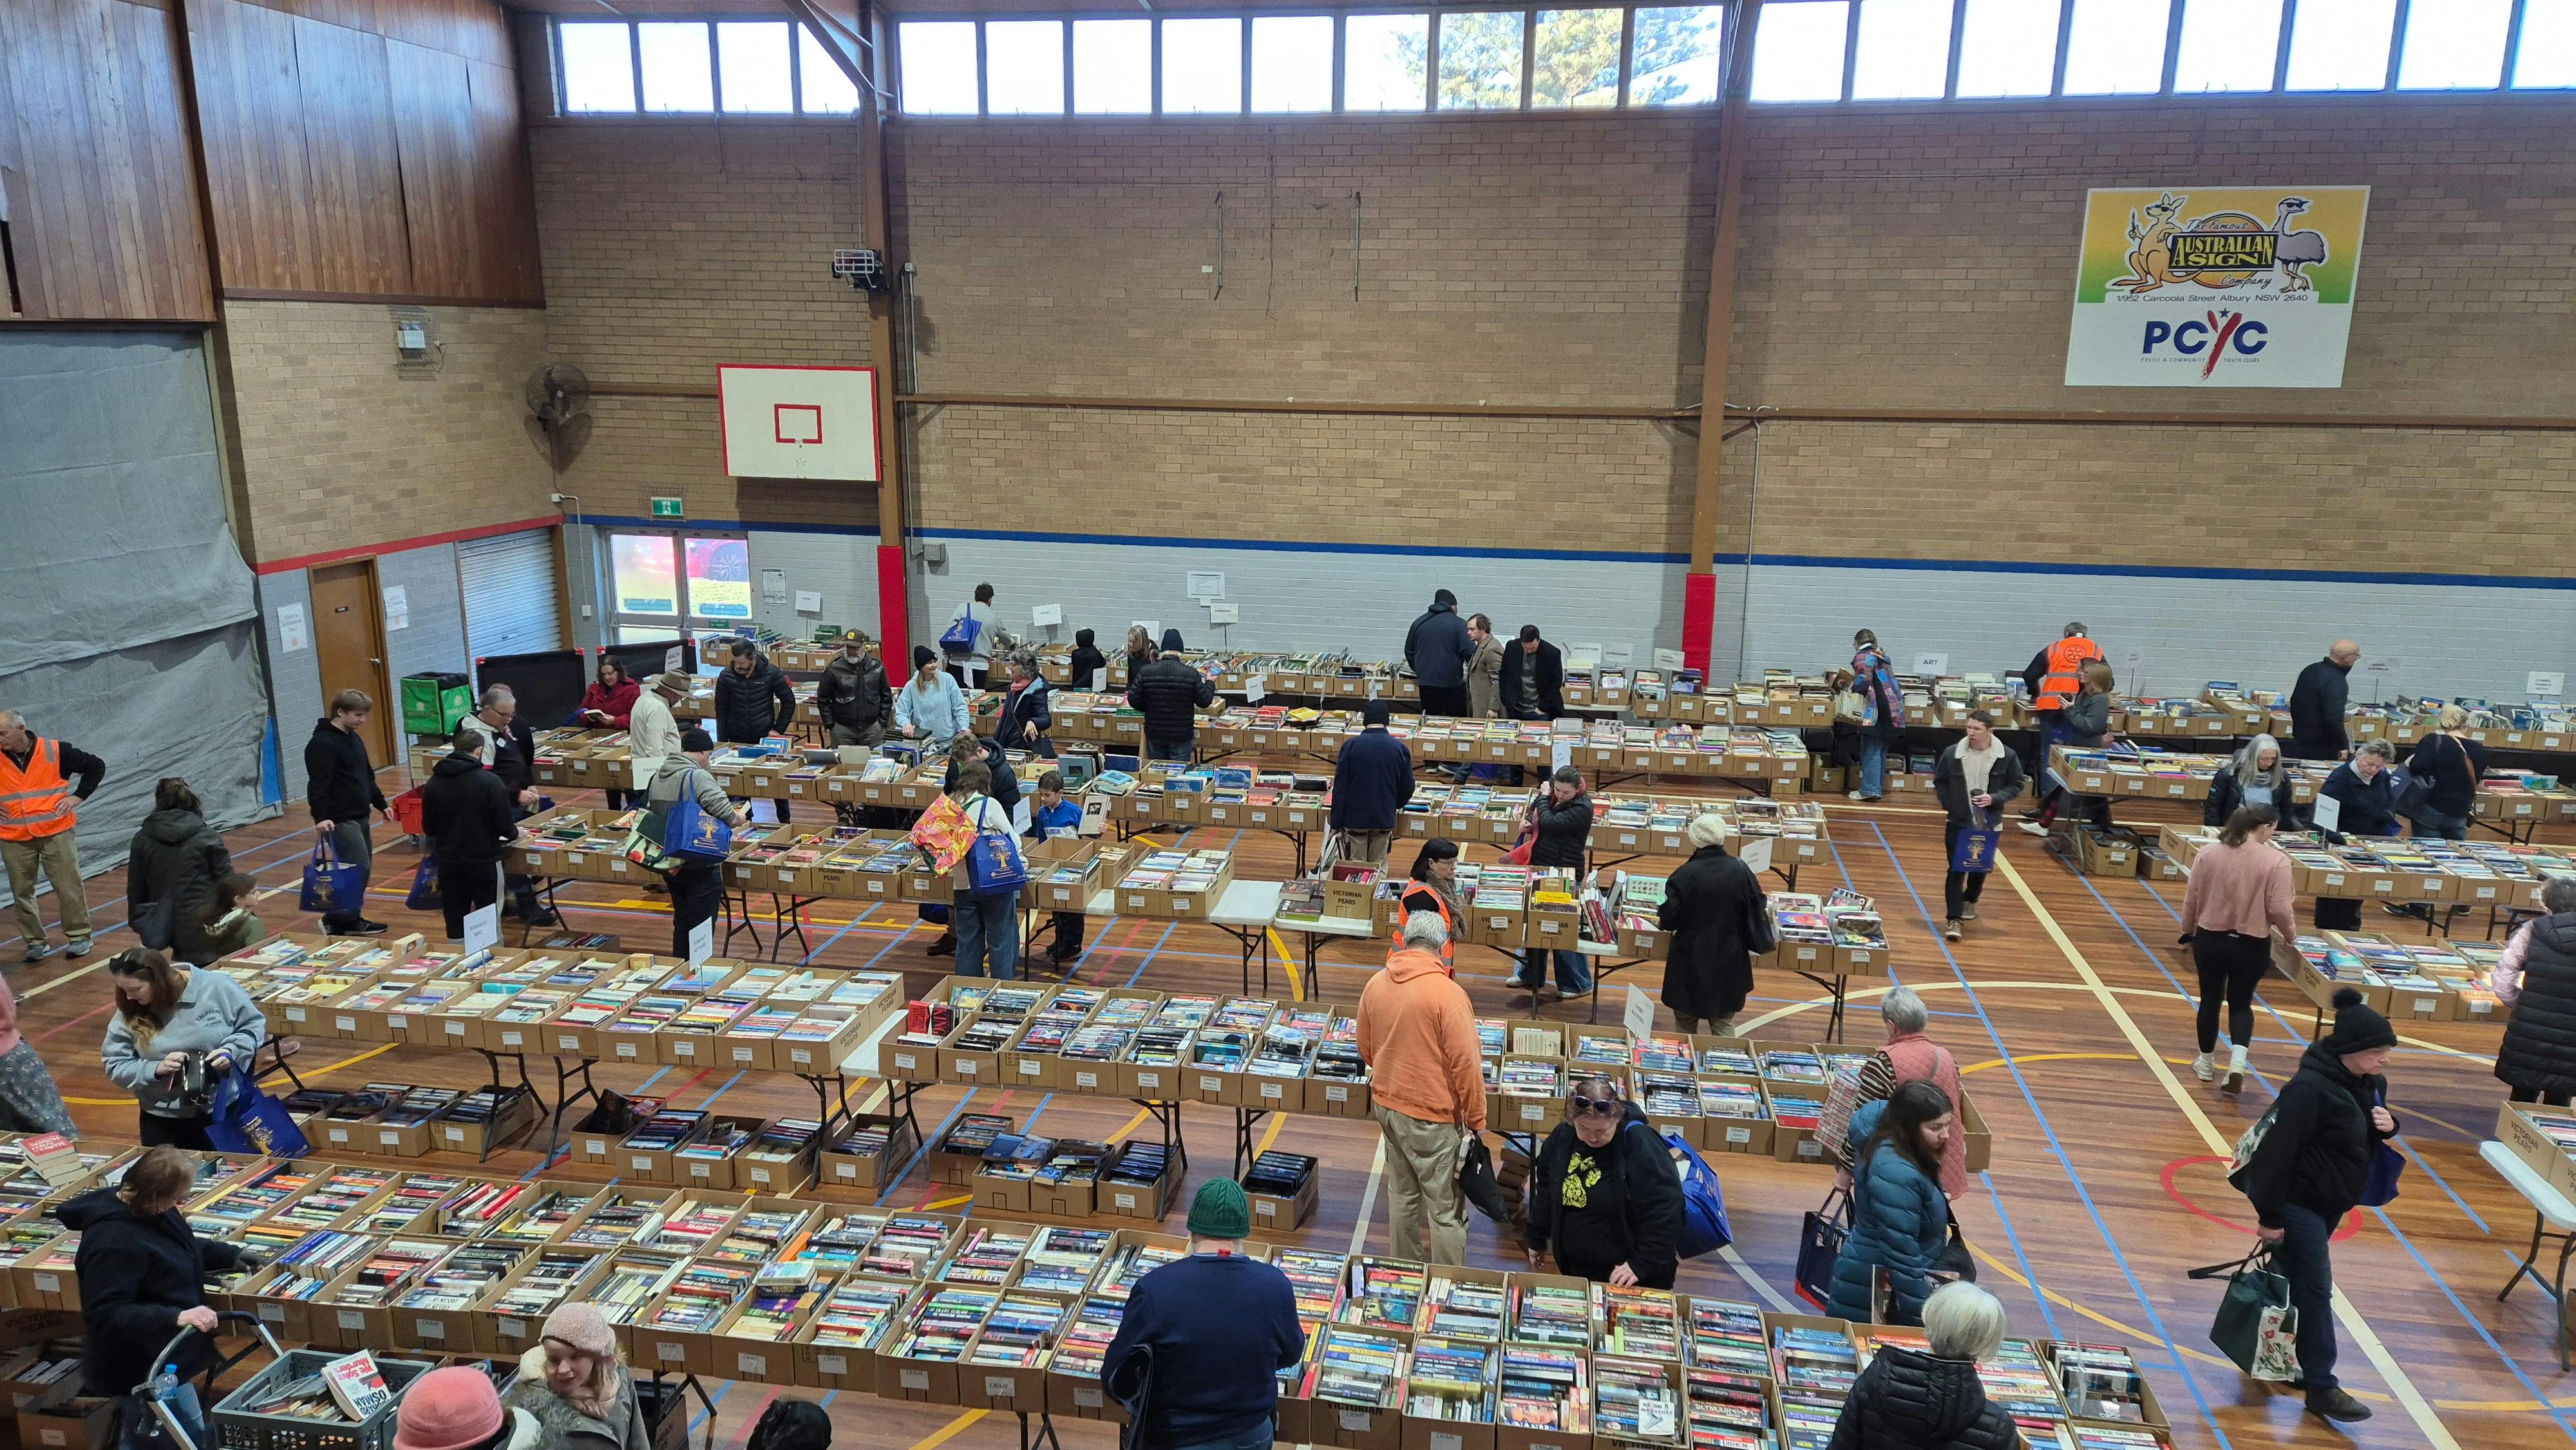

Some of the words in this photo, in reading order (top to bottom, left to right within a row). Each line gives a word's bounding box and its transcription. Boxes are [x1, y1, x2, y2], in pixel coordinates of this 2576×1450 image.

[2187, 219, 2206, 230] The
[2206, 220, 2248, 230] Famous
[2171, 236, 2275, 267] AUSTRALIAN
[2188, 252, 2259, 266] SIGN
[2221, 274, 2273, 290] Company
[2220, 295, 2251, 303] Albury
[2143, 310, 2268, 379] PCYC
[878, 988, 896, 1009] VICTORIAN
[881, 999, 894, 1013] PEARS
[933, 1008, 947, 1035] KING
[840, 1022, 861, 1044] VICTORIAN
[844, 1031, 858, 1050] PEARS
[2512, 1120, 2539, 1151] VICTORIAN
[2514, 1133, 2532, 1154] PEARS
[332, 1357, 370, 1373] Murders
[361, 1364, 374, 1374] We
[352, 1389, 387, 1408] OSMAN
[1327, 1402, 1383, 1415] VICTORIAN
[1695, 1404, 1731, 1414] SEYMOUR
